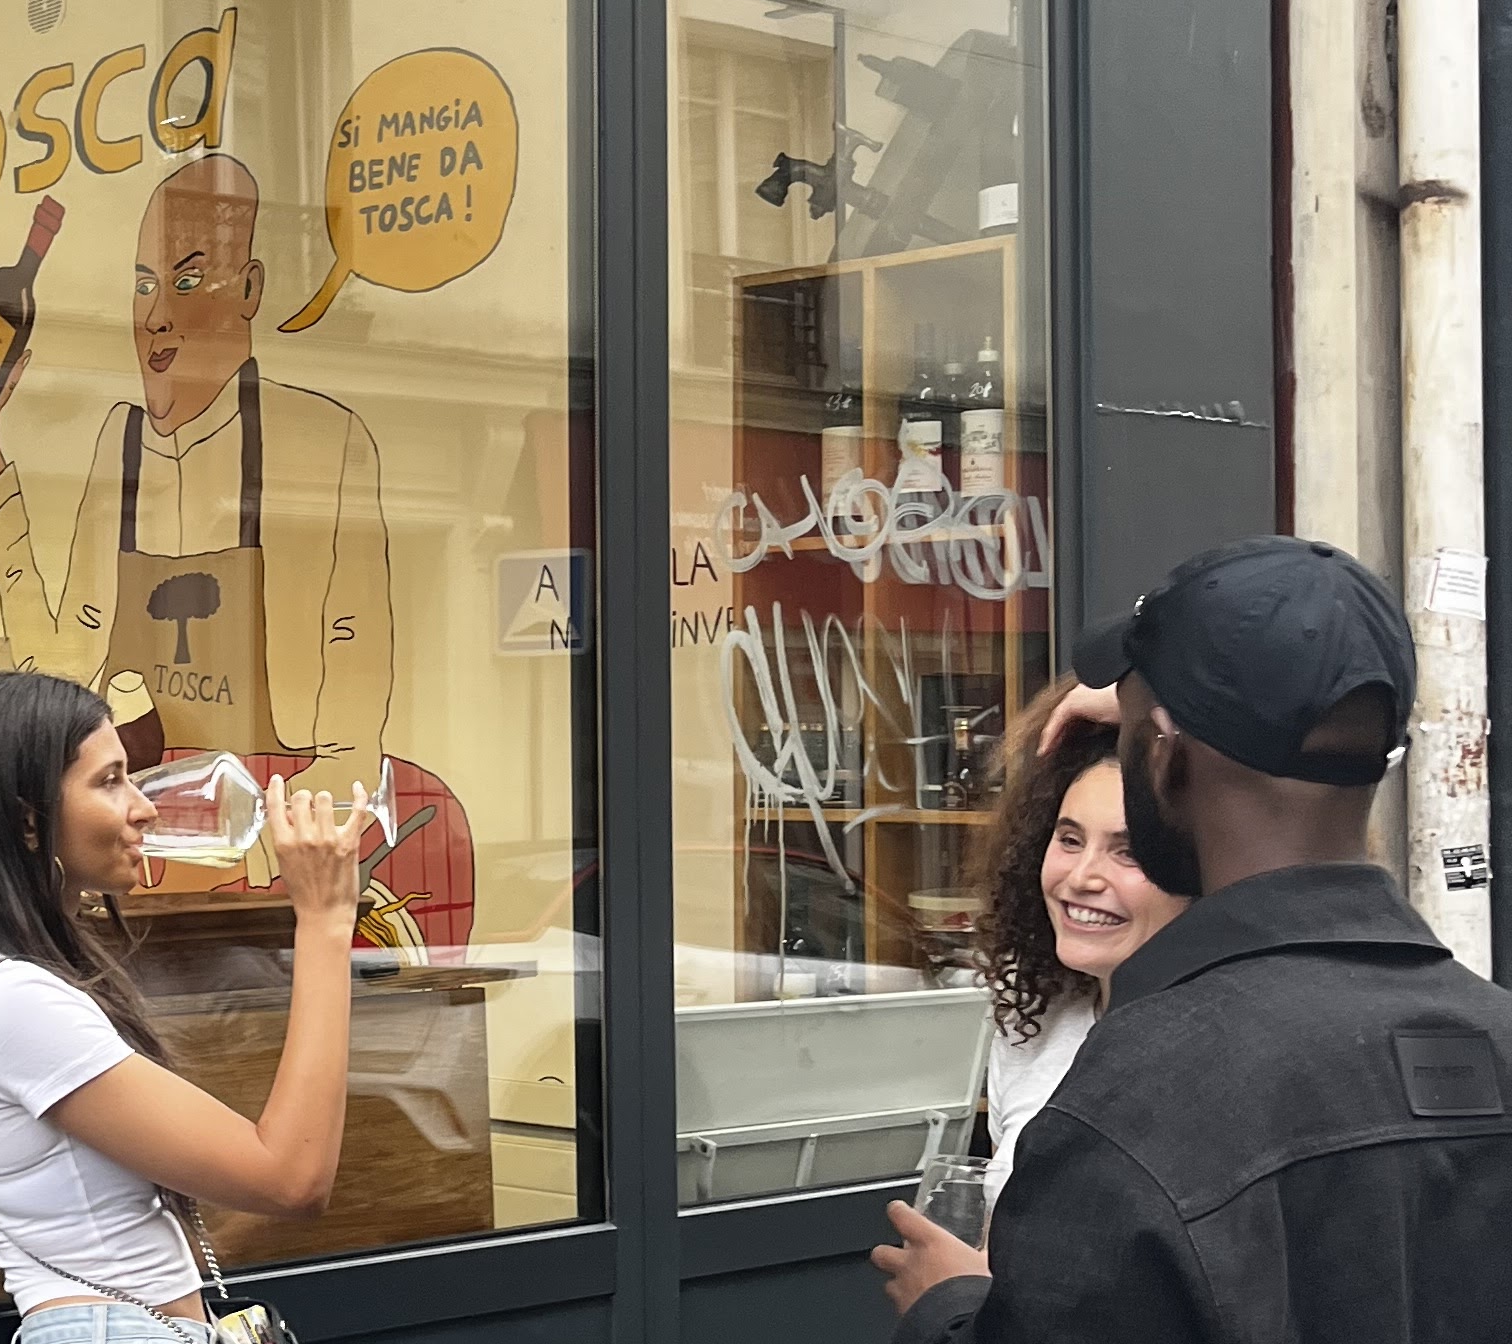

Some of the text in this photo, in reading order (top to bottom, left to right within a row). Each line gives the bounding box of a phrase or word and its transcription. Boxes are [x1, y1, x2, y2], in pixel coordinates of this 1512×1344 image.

[347, 140, 485, 194] BENE DA
[359, 197, 455, 235] TOSCA
[153, 664, 234, 706] TOSCA
